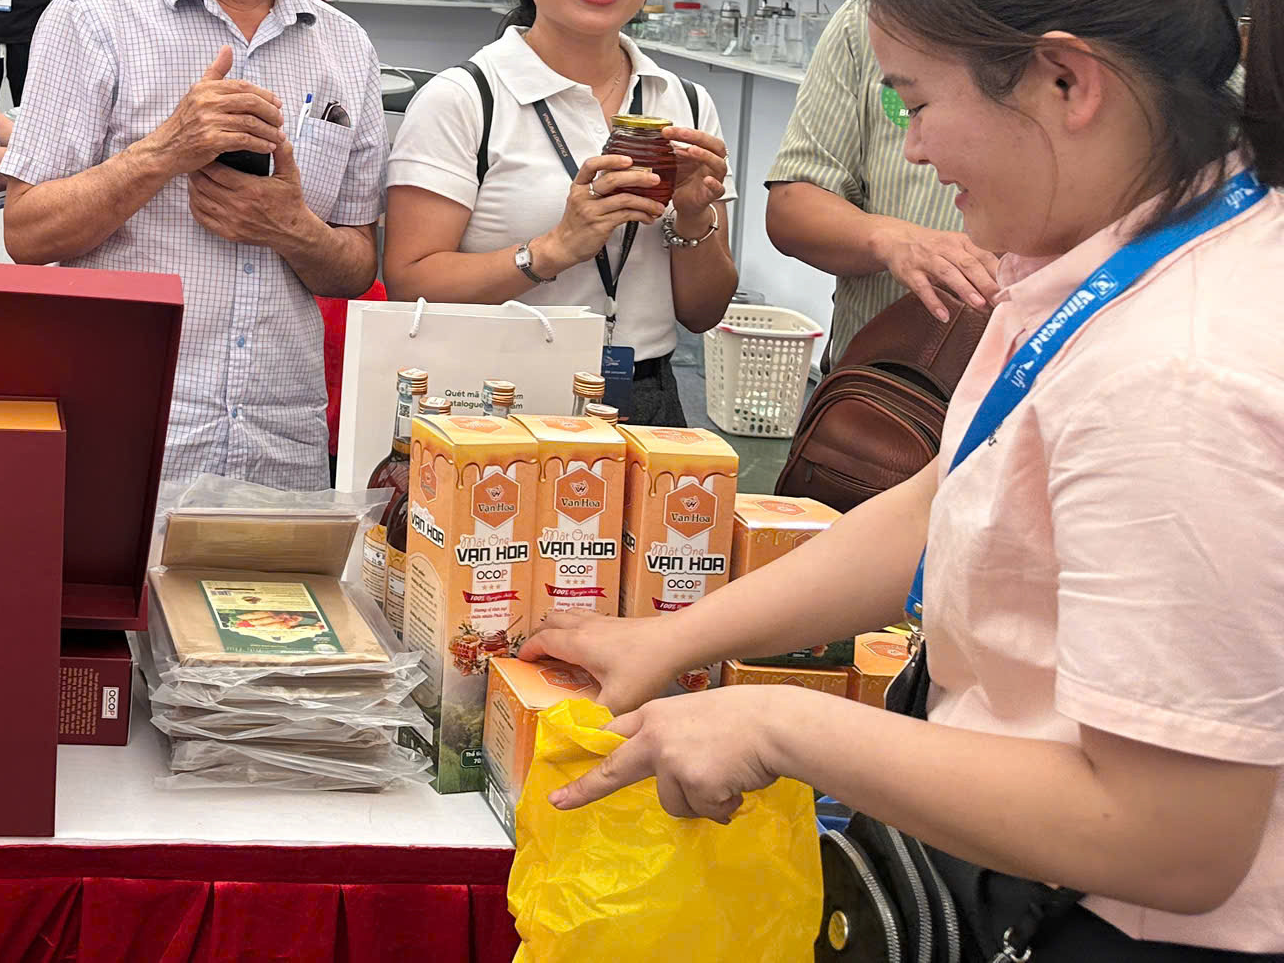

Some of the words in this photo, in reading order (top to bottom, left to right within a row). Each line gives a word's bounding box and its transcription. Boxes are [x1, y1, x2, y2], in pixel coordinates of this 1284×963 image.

[1028, 289, 1096, 355] Vinexad
[444, 389, 466, 398] Quét
[467, 390, 480, 398] mã
[450, 400, 484, 410] atalogue
[497, 502, 515, 513] Hoa
[581, 497, 601, 508] Hoa
[691, 512, 711, 524] Hoa
[426, 523, 445, 545] HOA
[457, 547, 491, 564] VẠN
[496, 544, 529, 561] HOA
[539, 540, 575, 558] VẠN
[580, 540, 615, 556] HOA
[646, 554, 683, 573] VẠN
[689, 556, 725, 572] HOA
[476, 569, 509, 580] OCOP
[559, 564, 594, 575] OCOP
[667, 578, 702, 589] OCOP
[107, 689, 117, 716] OCOP
